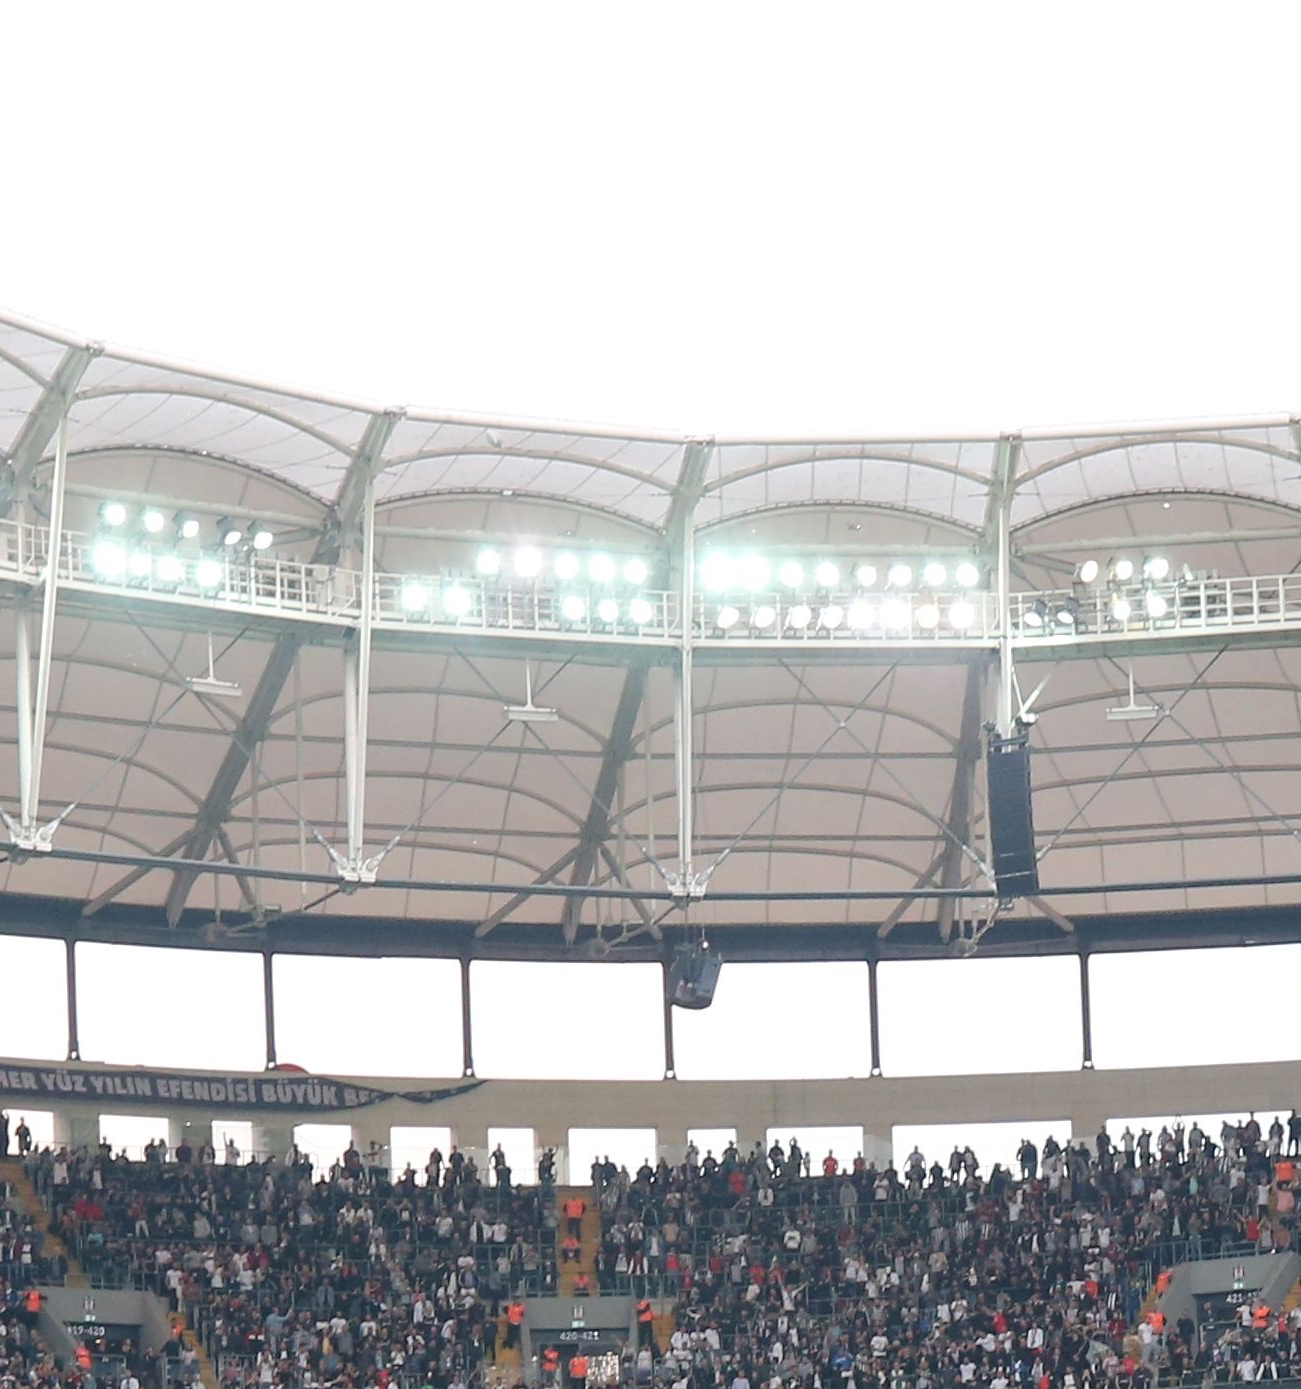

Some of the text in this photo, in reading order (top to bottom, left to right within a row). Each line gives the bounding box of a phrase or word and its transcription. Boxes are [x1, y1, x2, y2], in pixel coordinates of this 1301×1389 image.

[40, 1069, 88, 1093] YÜZ
[89, 1074, 151, 1097] YILIN
[156, 1076, 256, 1103] EFENDİSİ
[261, 1079, 339, 1107] BÜYÜK
